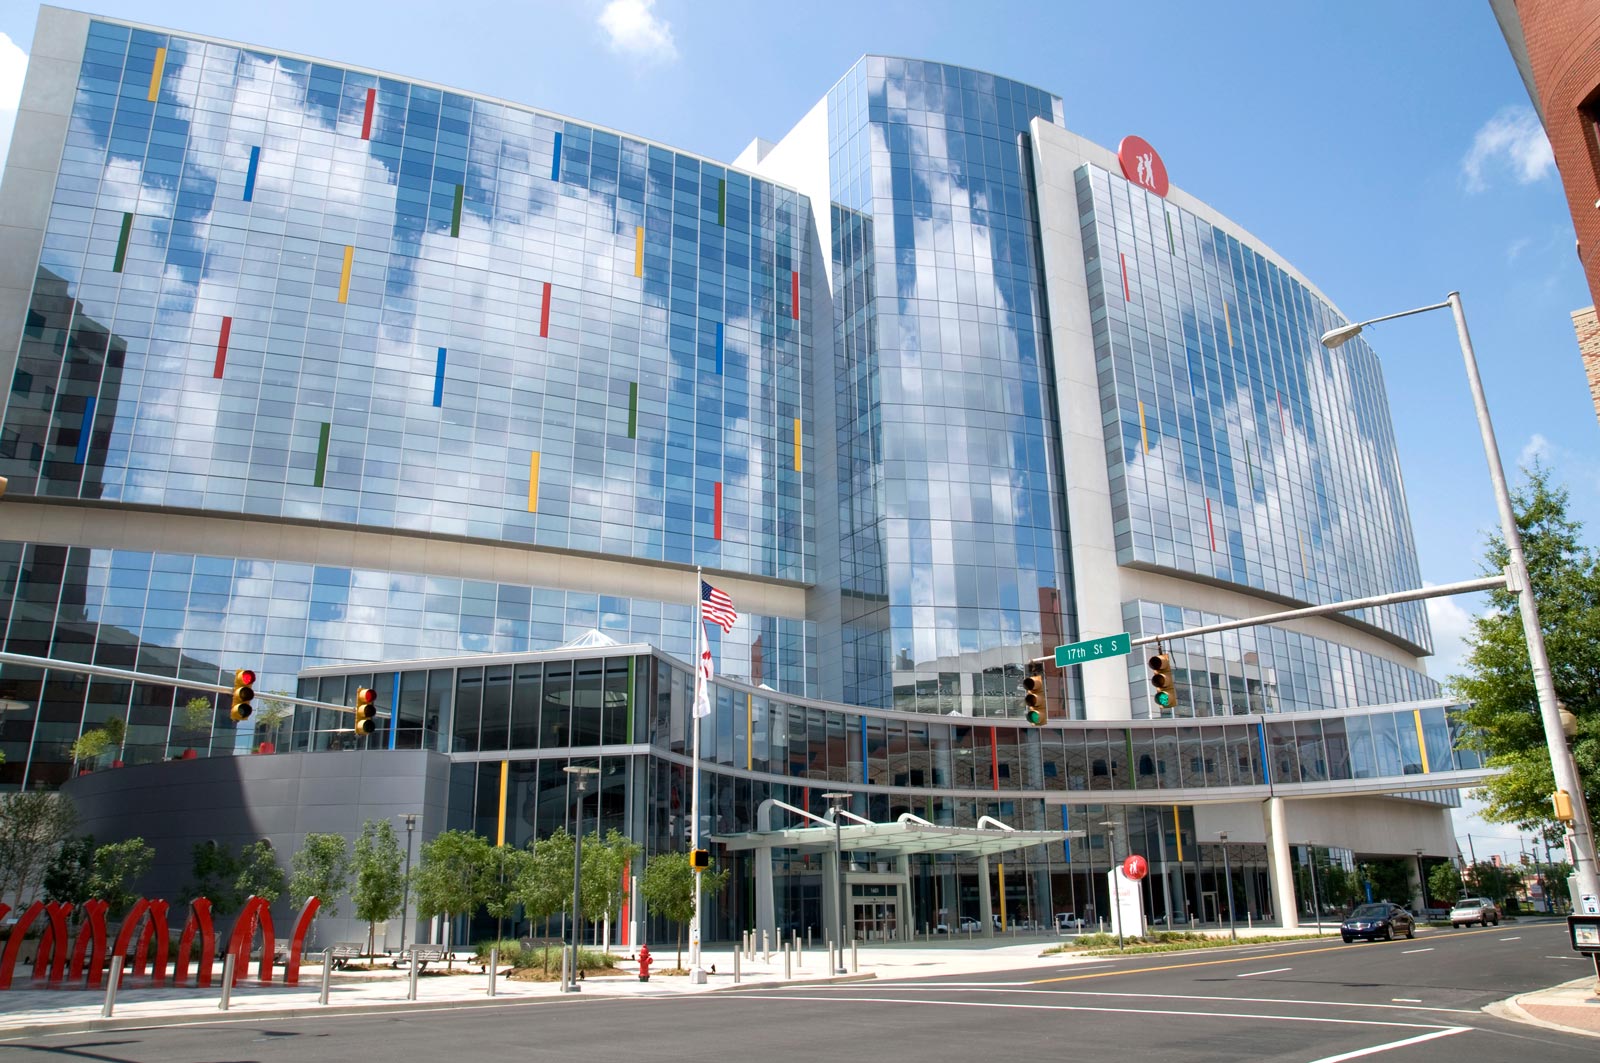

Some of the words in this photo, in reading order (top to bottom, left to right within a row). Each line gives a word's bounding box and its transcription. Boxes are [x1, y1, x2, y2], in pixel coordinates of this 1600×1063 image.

[1067, 648, 1086, 660] 17th
[1093, 643, 1103, 655] St
[1111, 640, 1118, 652] S
